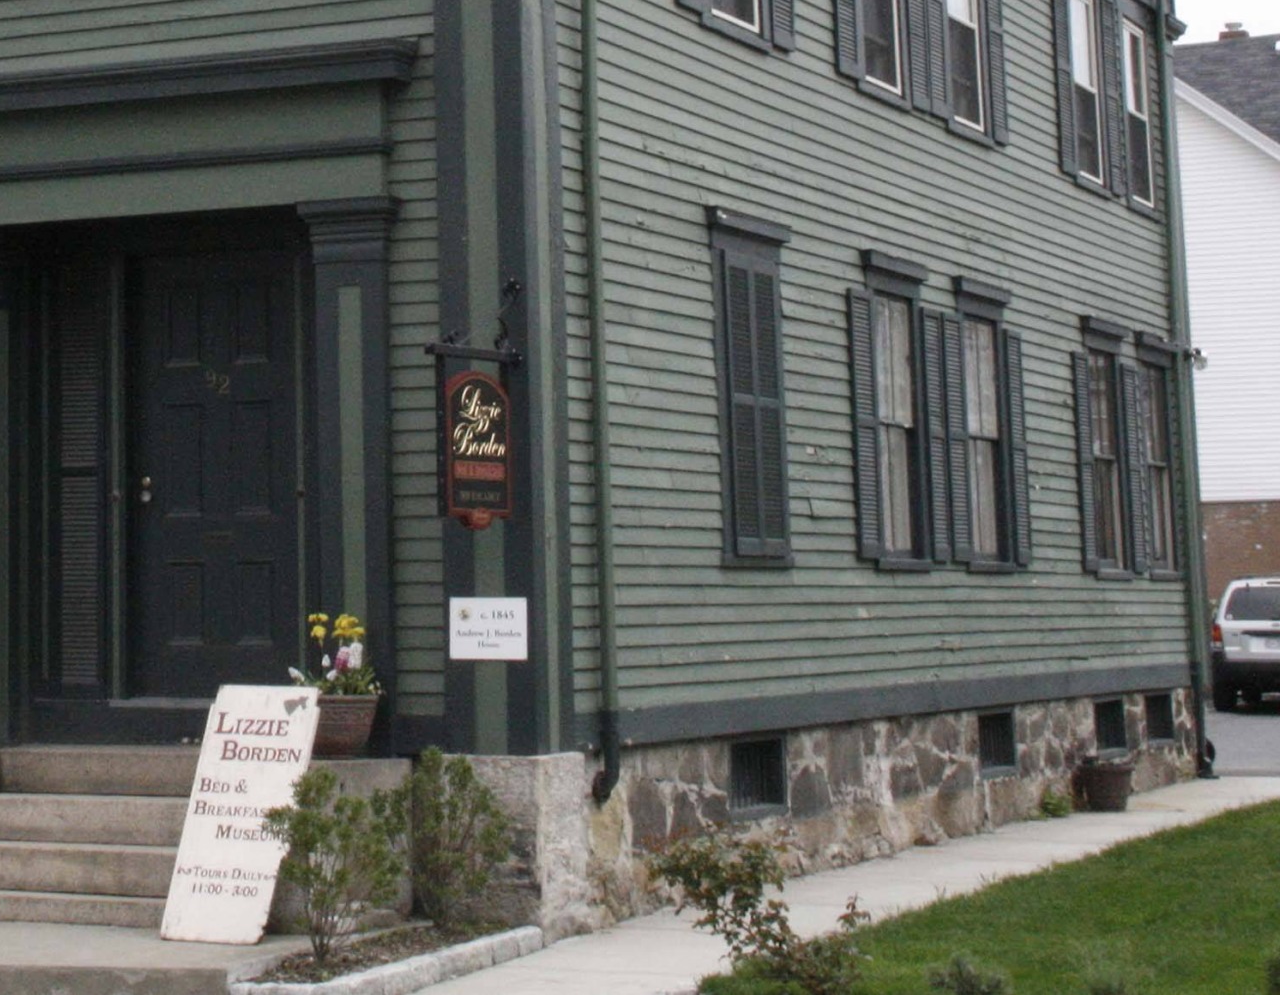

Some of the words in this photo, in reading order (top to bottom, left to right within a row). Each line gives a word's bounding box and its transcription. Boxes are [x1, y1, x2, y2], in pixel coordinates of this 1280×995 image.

[204, 368, 230, 395] 92
[458, 385, 502, 433] Lizzie
[453, 422, 506, 456] Borden
[492, 610, 515, 620] 1845
[214, 711, 290, 737] LIZZIE
[220, 740, 302, 763] BORDEN
[199, 777, 230, 793] BED
[234, 778, 248, 793] &
[193, 800, 268, 818] BREAKFAS
[193, 866, 227, 879] TOURS
[231, 868, 263, 881] DAILY
[192, 882, 222, 895] 11:00
